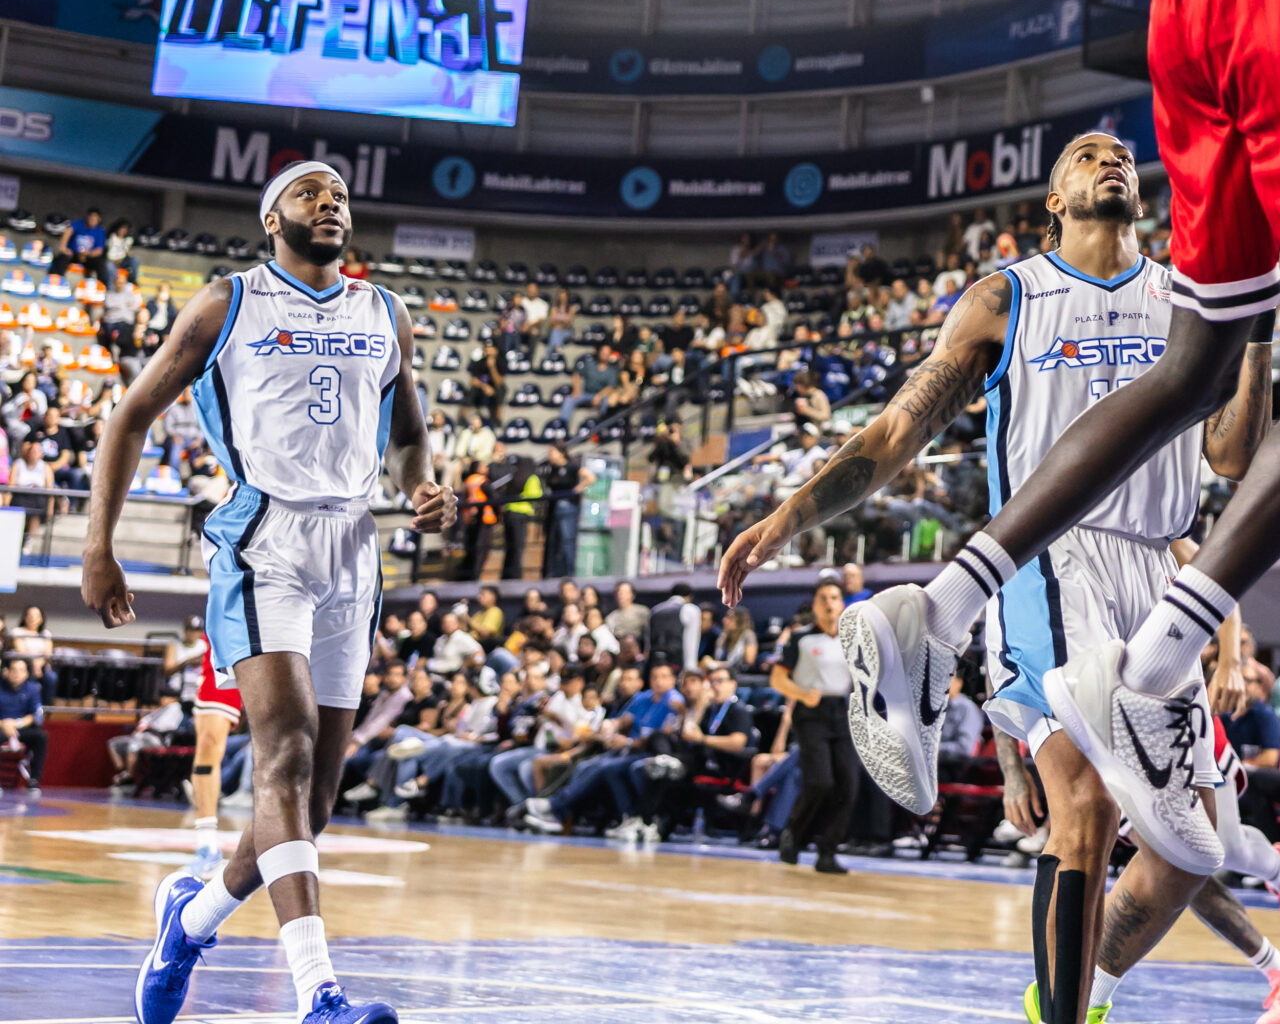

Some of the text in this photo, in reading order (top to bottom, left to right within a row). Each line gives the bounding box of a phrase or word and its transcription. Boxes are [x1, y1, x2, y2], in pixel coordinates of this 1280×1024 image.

[928, 125, 1043, 198] Mobil
[316, 313, 325, 324] P
[1075, 311, 1150, 326] PLAZA P PATRA
[246, 327, 386, 359] ASTROS
[1028, 336, 1170, 372] ASTRO
[308, 364, 342, 425] 3
